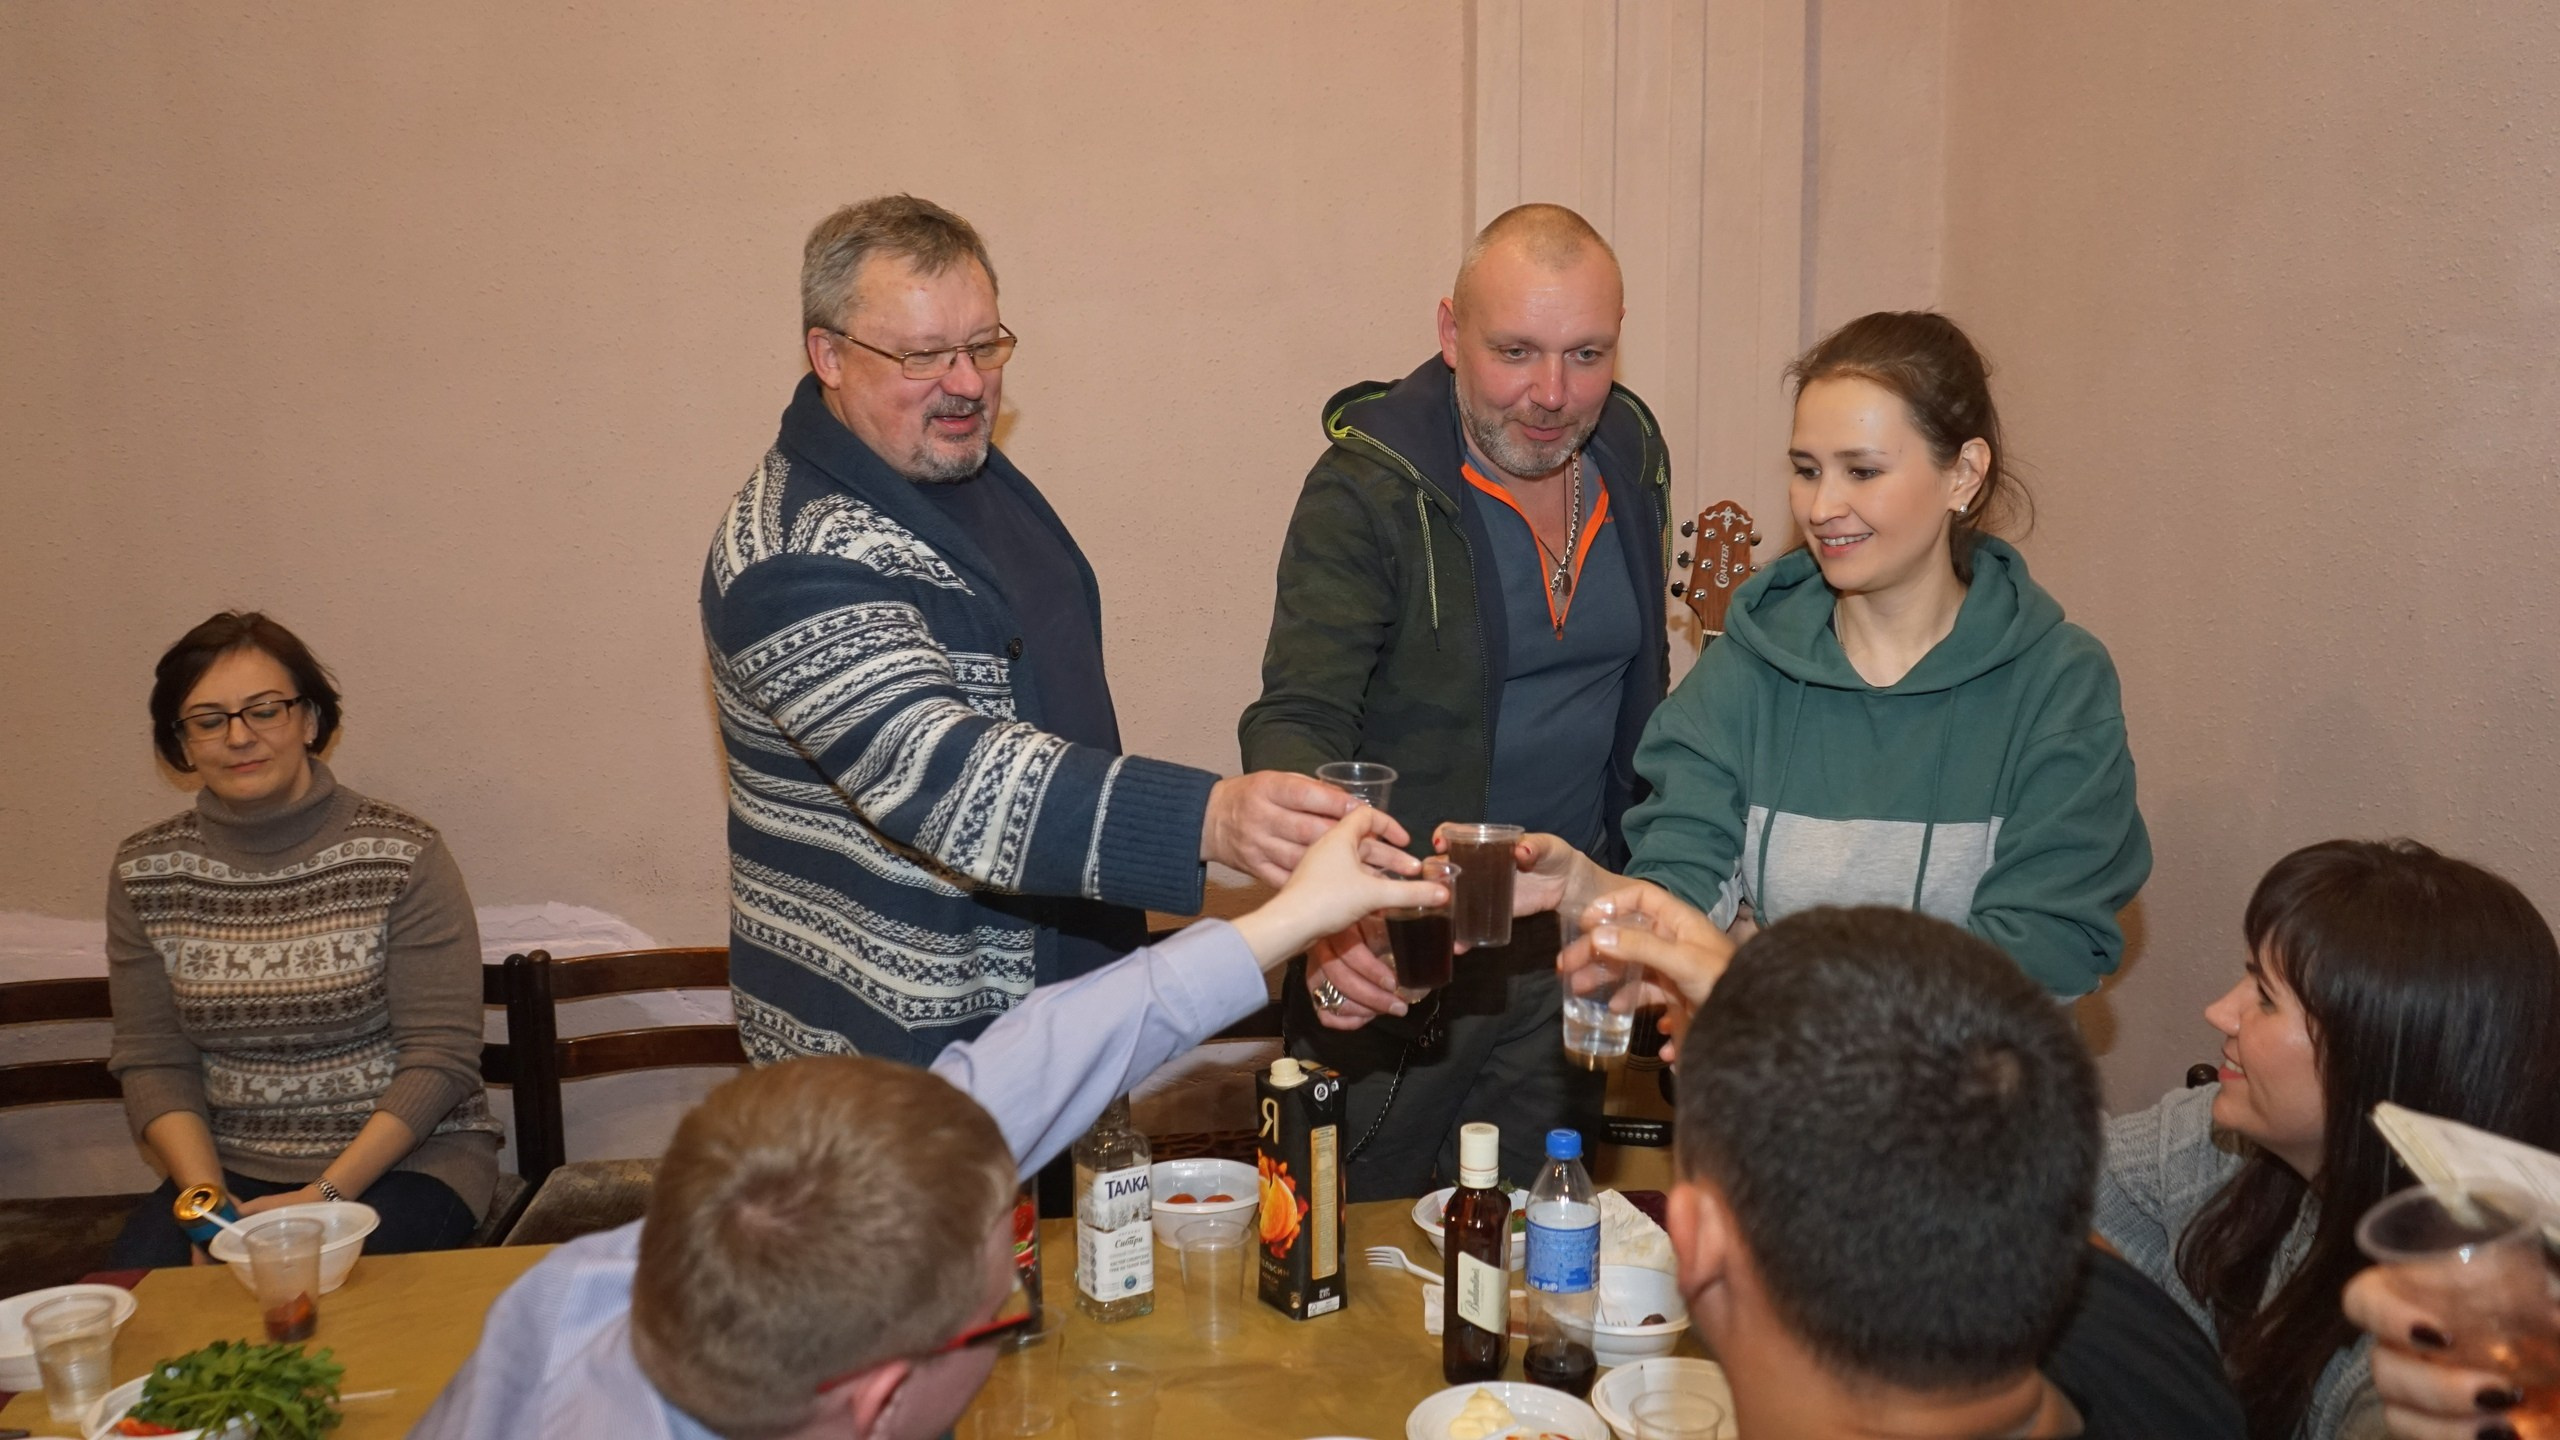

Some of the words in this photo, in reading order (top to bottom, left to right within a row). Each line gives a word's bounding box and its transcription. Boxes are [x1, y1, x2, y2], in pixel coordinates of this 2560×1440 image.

[1714, 543, 1729, 588] CRAFTER
[1258, 1097, 1279, 1145] Я
[1104, 1173, 1150, 1200] ТАЛКА
